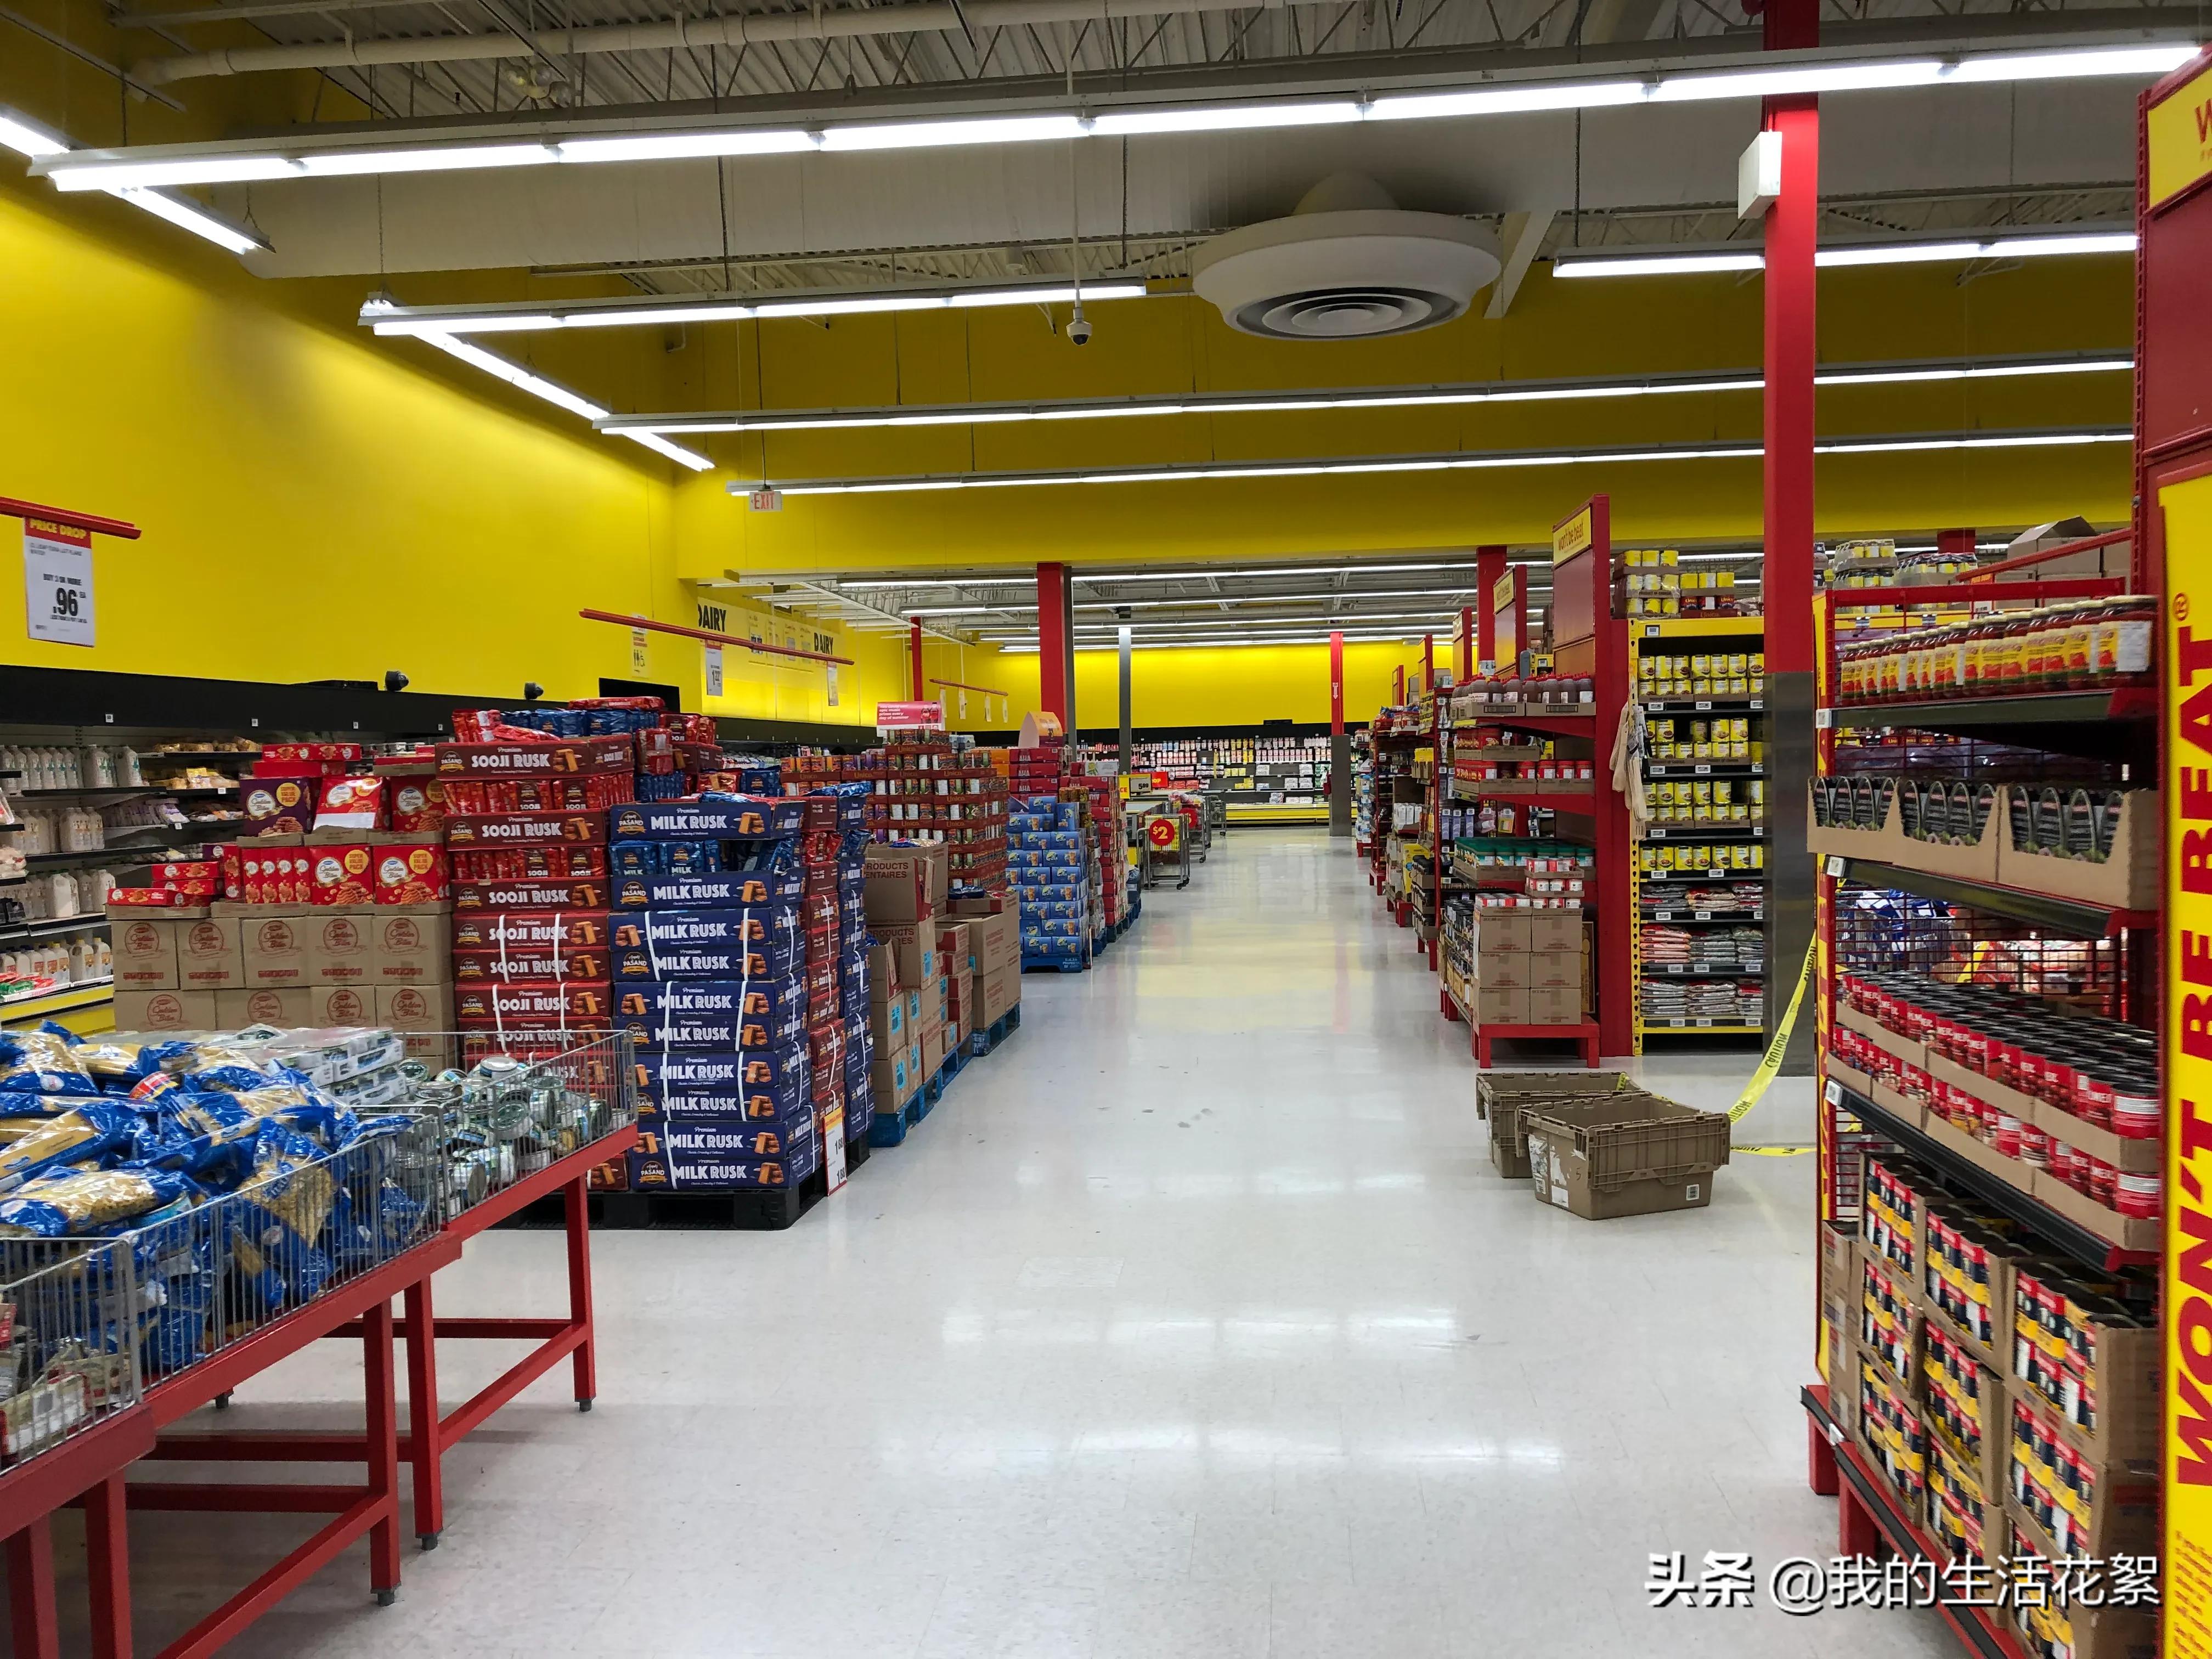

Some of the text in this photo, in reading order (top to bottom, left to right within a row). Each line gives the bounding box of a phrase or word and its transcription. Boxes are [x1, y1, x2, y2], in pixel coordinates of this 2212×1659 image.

[754, 493, 775, 509] EXIT
[30, 518, 87, 539] PRICE DROP
[814, 633, 834, 655] DAIRY
[471, 753, 550, 768] SOOJI RUSK
[482, 823, 562, 837] SOOJI RUSK
[651, 815, 727, 830] MILK RUSK
[1153, 826, 1168, 839] $2
[866, 862, 909, 870] RODUCTS
[489, 889, 569, 904] SOOJI RUSK
[653, 884, 730, 900] MILK RUSK
[651, 923, 727, 939] MILK RUSK
[654, 956, 729, 970] MILK RUSK
[657, 995, 732, 1009] MILK RUSK
[2179, 929, 2212, 1061] BE
[493, 996, 571, 1011] OOJI RUSK
[655, 1027, 730, 1041] MILK RUSK
[659, 1065, 734, 1080] MILK RUSK
[662, 1097, 737, 1111] MILK RUSK
[670, 1134, 743, 1148] MILK RUSK
[674, 1166, 747, 1180] MILK RUSK
